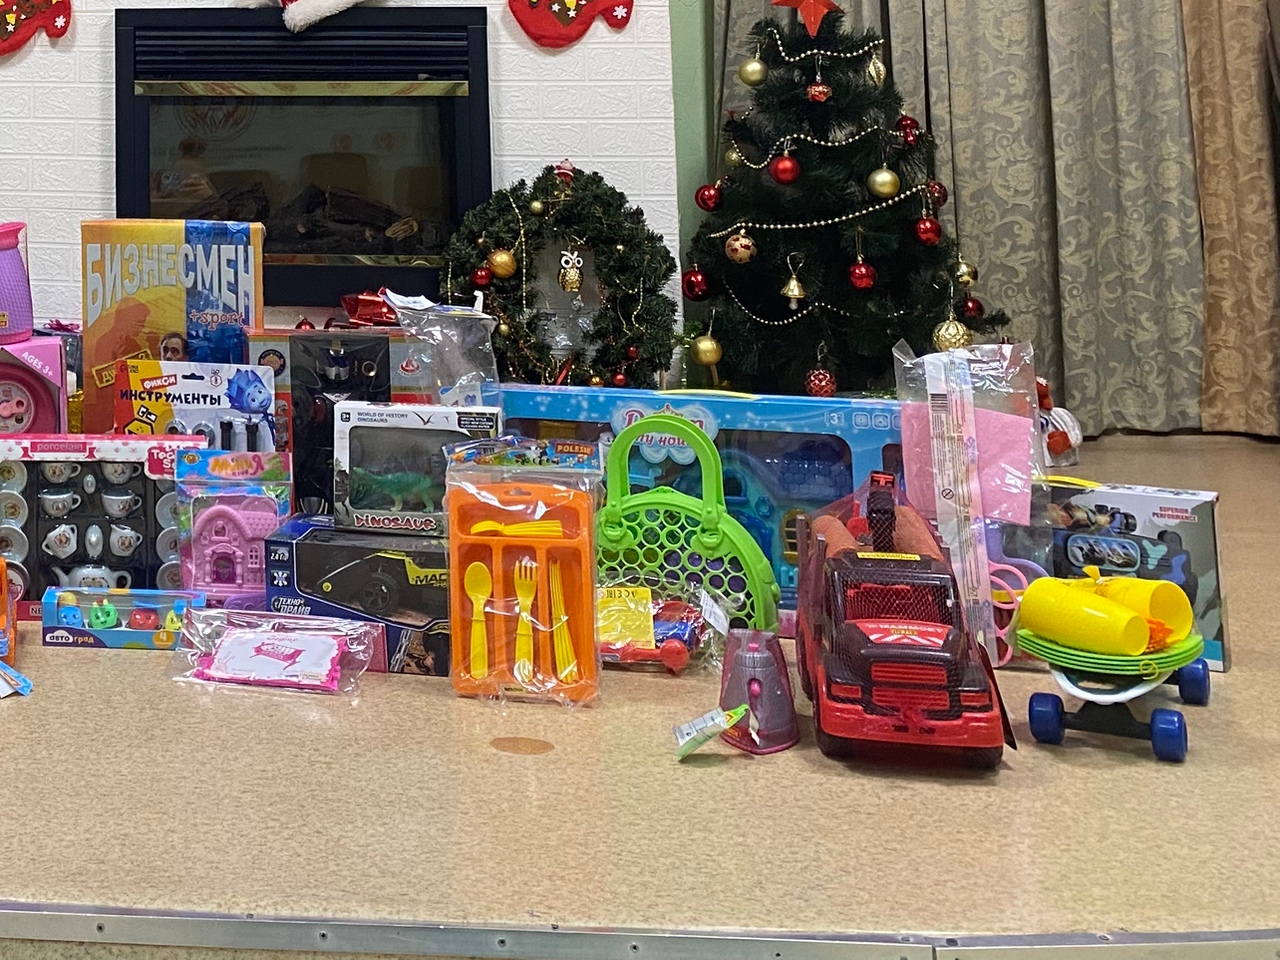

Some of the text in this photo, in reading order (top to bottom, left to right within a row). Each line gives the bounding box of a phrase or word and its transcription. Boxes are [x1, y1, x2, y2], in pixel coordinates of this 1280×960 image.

[86, 243, 255, 330] БИЗНЕСМЕН
[190, 310, 244, 330] +sport
[21, 351, 54, 377] AGES 3+
[144, 376, 176, 389] ФИКСИ
[120, 390, 221, 406] ИНСТРУМЕНТЫ
[36, 442, 84, 452] porcelain
[1152, 512, 1197, 522] PERFORMANCE
[1159, 506, 1189, 514] SUPERIOR
